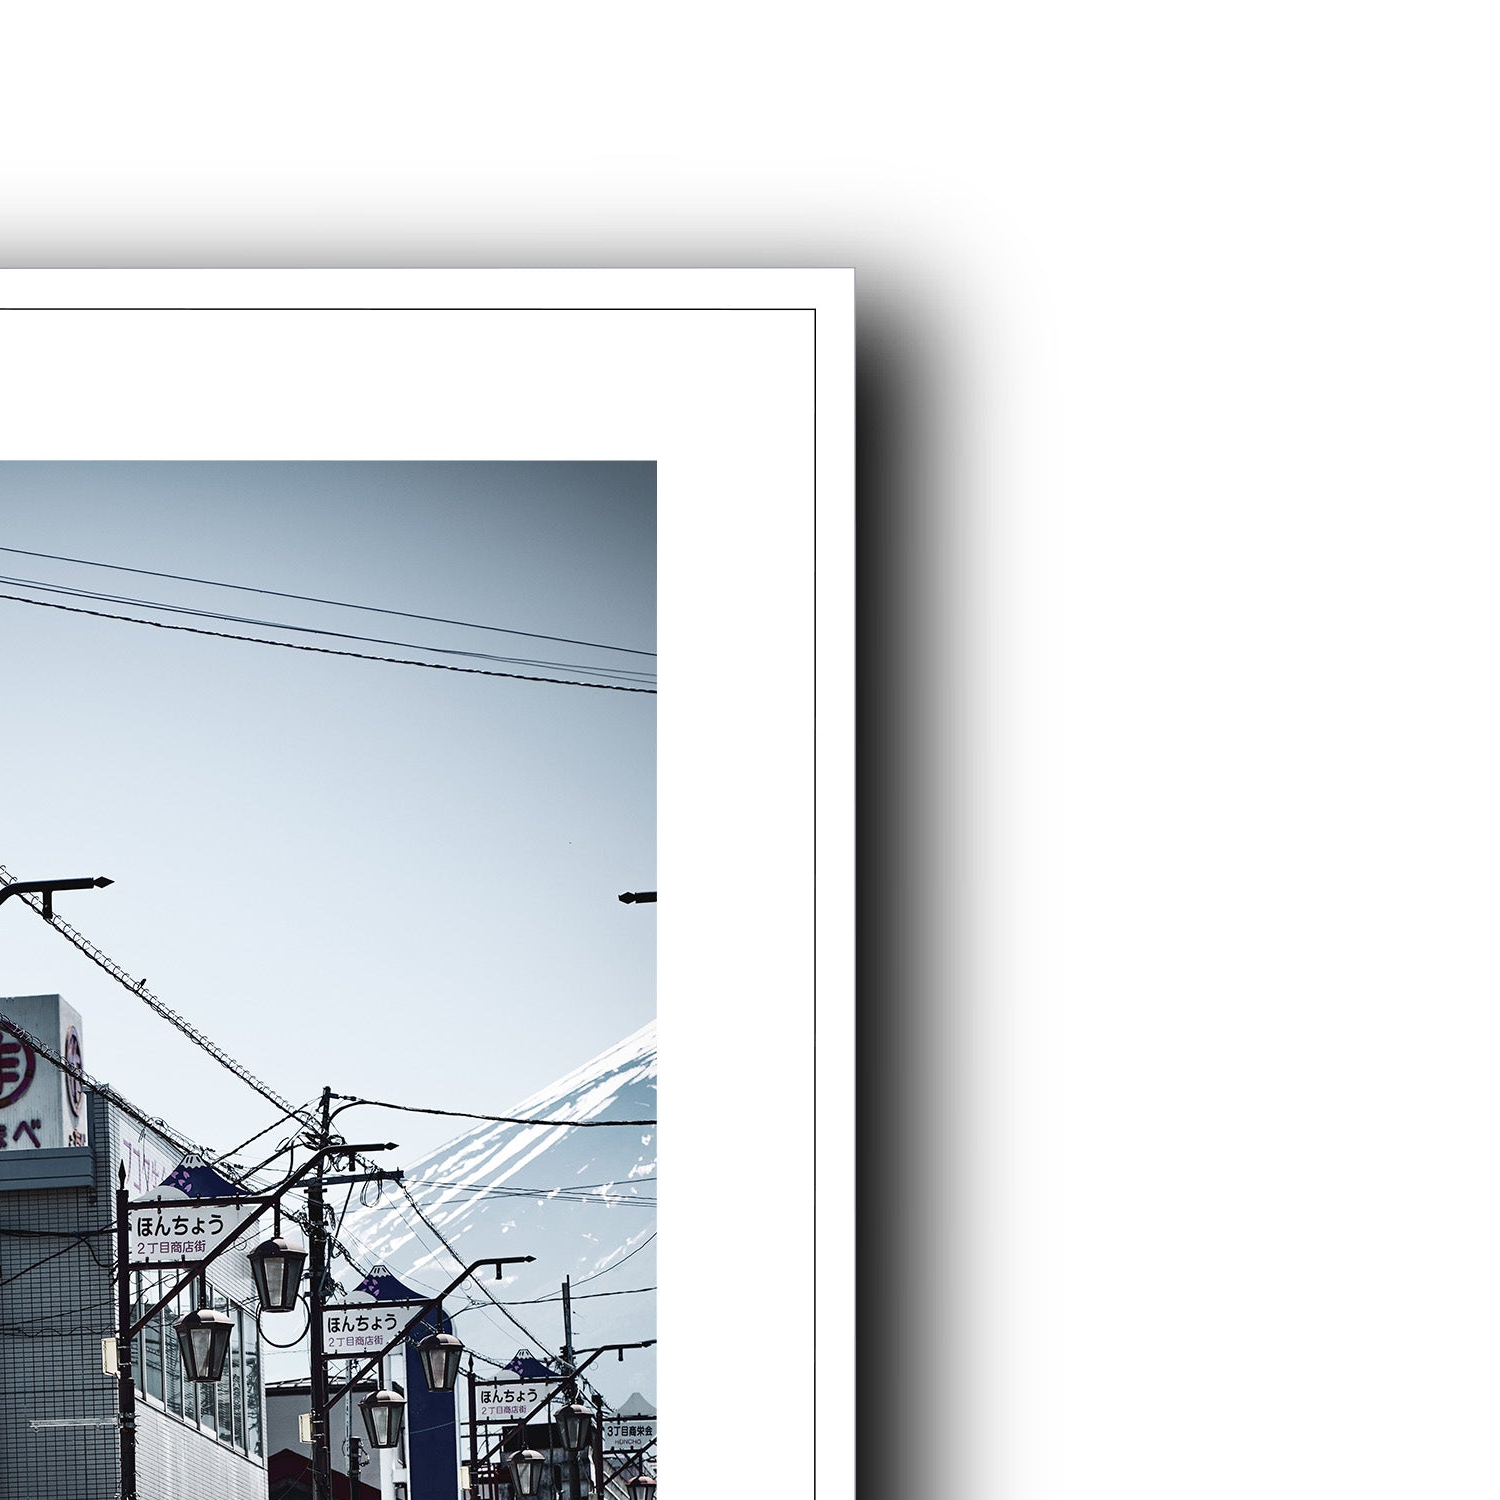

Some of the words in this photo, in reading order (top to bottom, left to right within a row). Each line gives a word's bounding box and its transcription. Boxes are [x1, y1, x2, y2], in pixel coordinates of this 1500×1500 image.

[137, 1214, 224, 1237] ほんちょう
[137, 1240, 206, 1254] 2丁目商店街
[328, 1313, 397, 1333] ほんちょう
[328, 1335, 383, 1347] 2丁目商店街
[480, 1388, 538, 1404] ほんちょう
